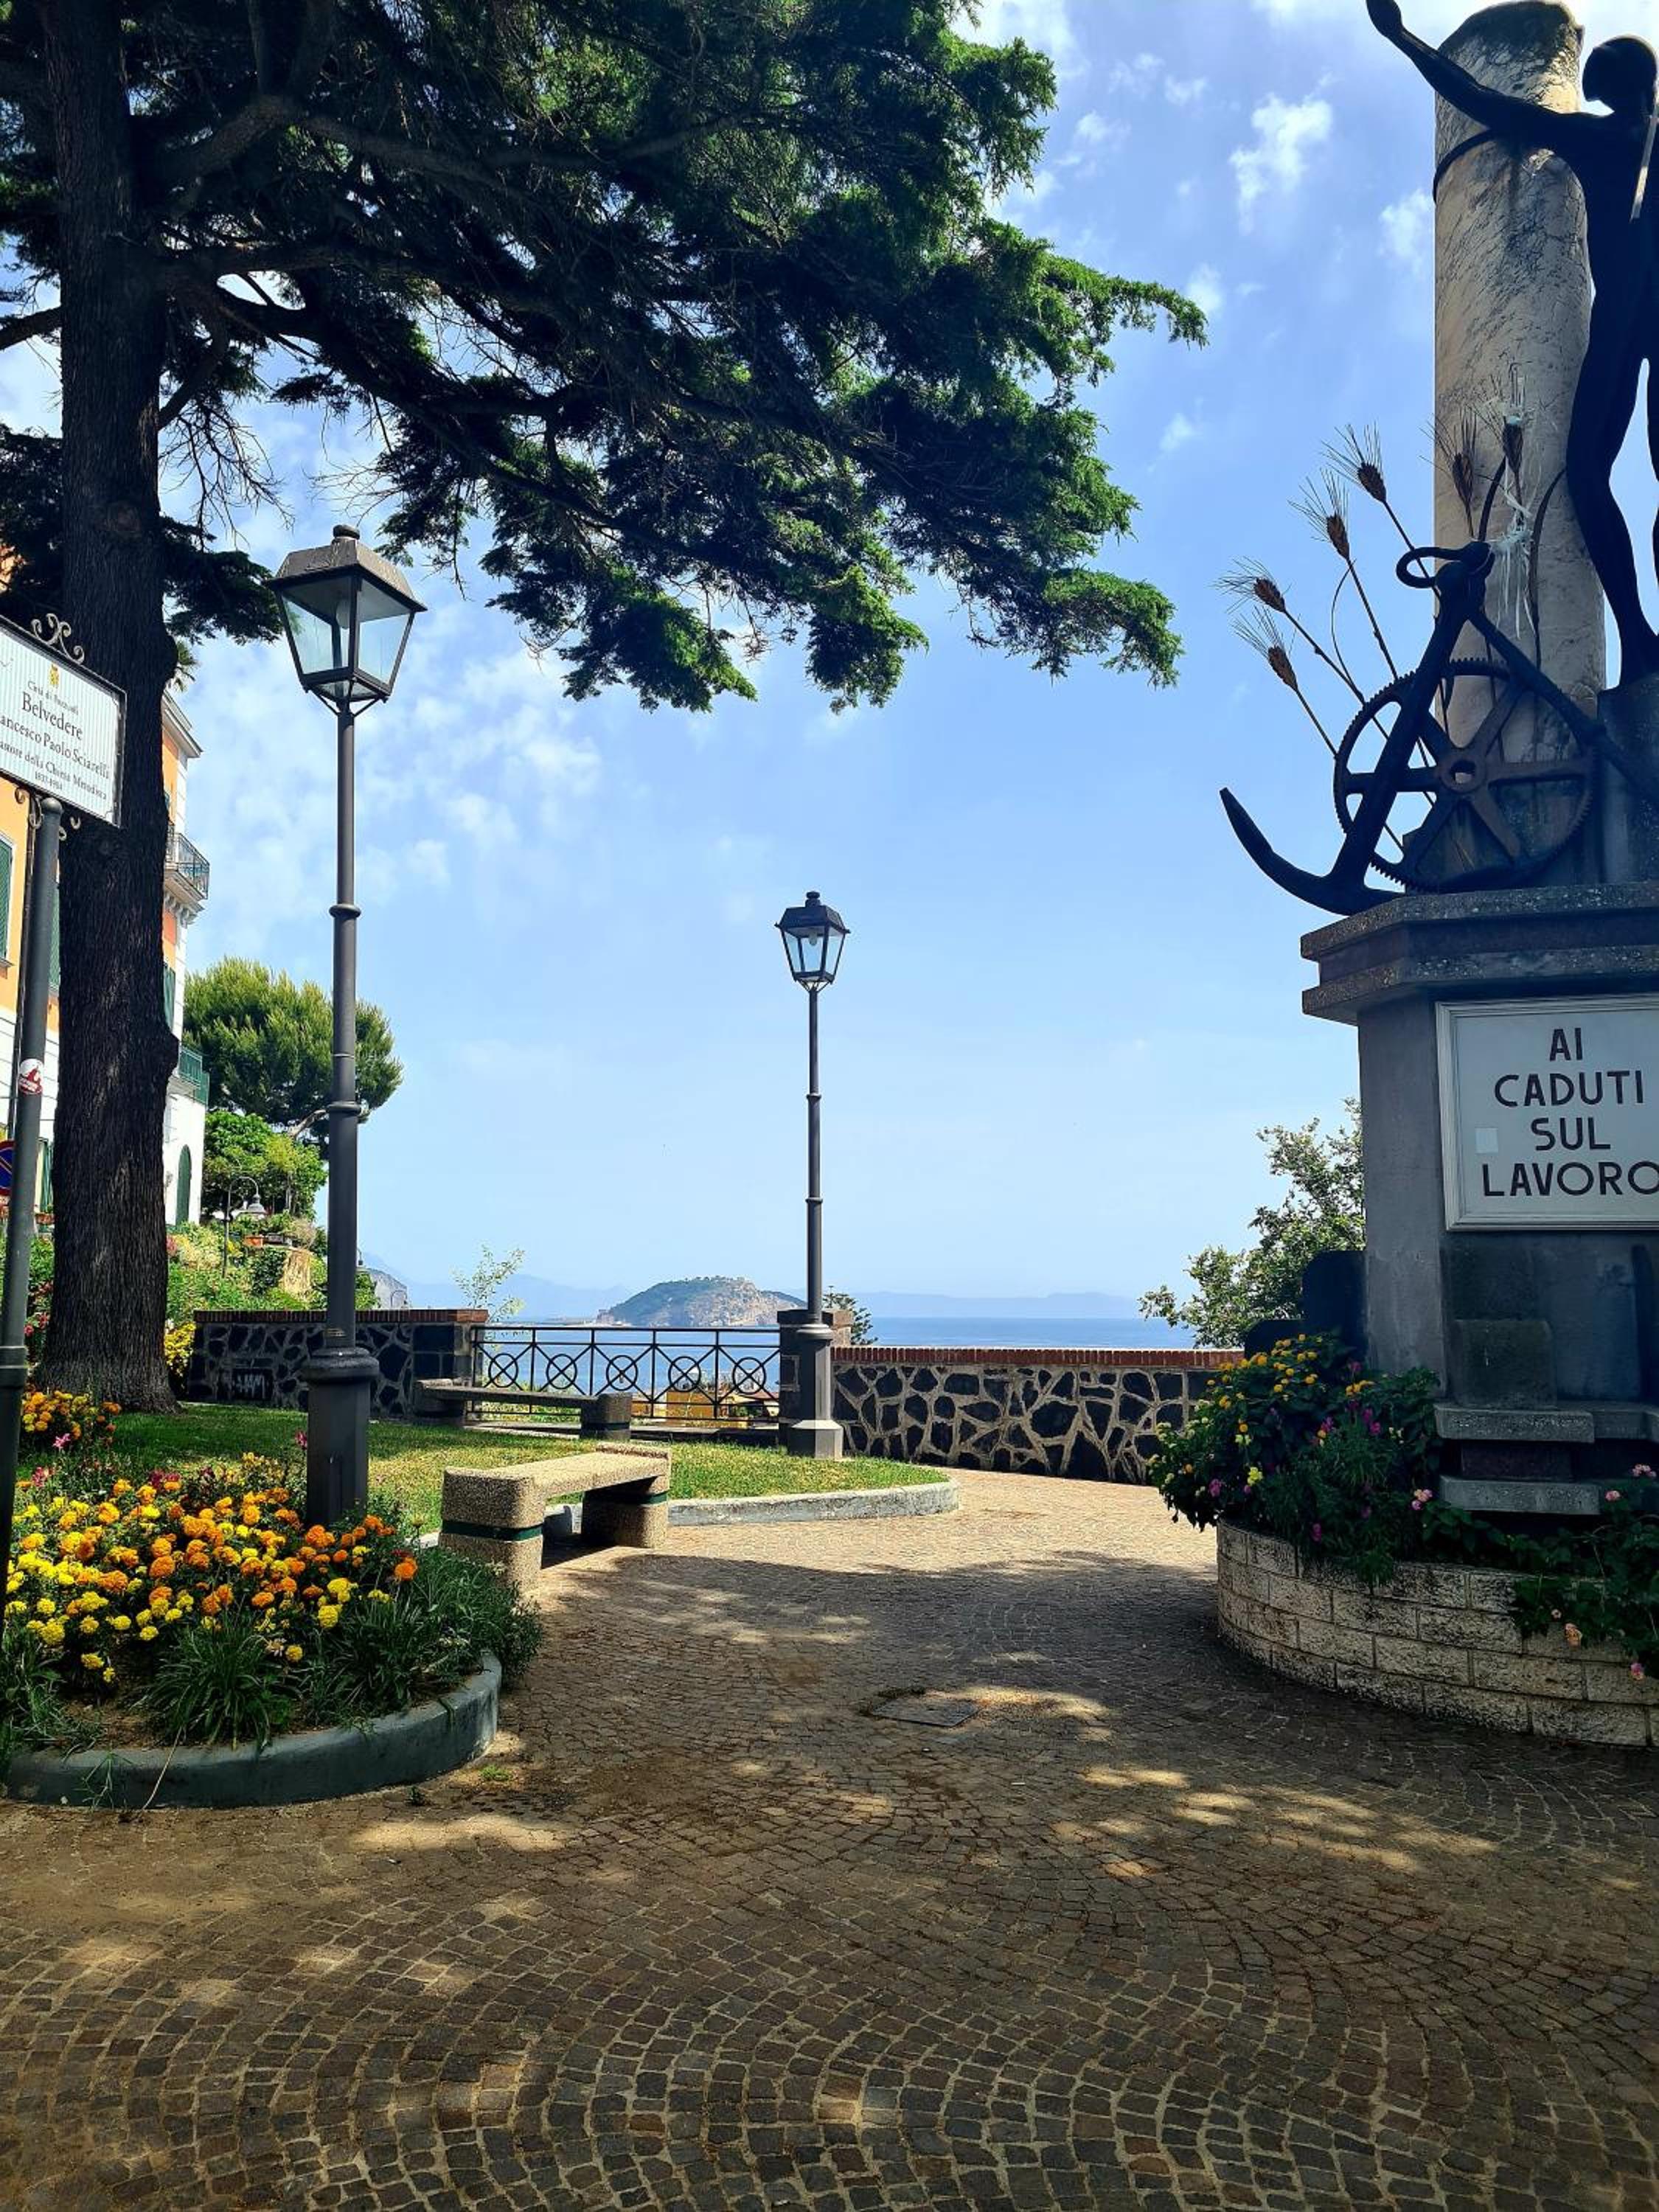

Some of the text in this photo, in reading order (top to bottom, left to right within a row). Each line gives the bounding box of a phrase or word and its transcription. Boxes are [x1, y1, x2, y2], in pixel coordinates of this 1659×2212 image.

[22, 691, 83, 740] Belvedere
[44, 732, 72, 758] Paolo
[1549, 1027, 1584, 1062] AI
[1494, 1070, 1644, 1107] CADUTI
[1530, 1117, 1611, 1151] SUL
[1481, 1161, 1659, 1197] LAVORO
